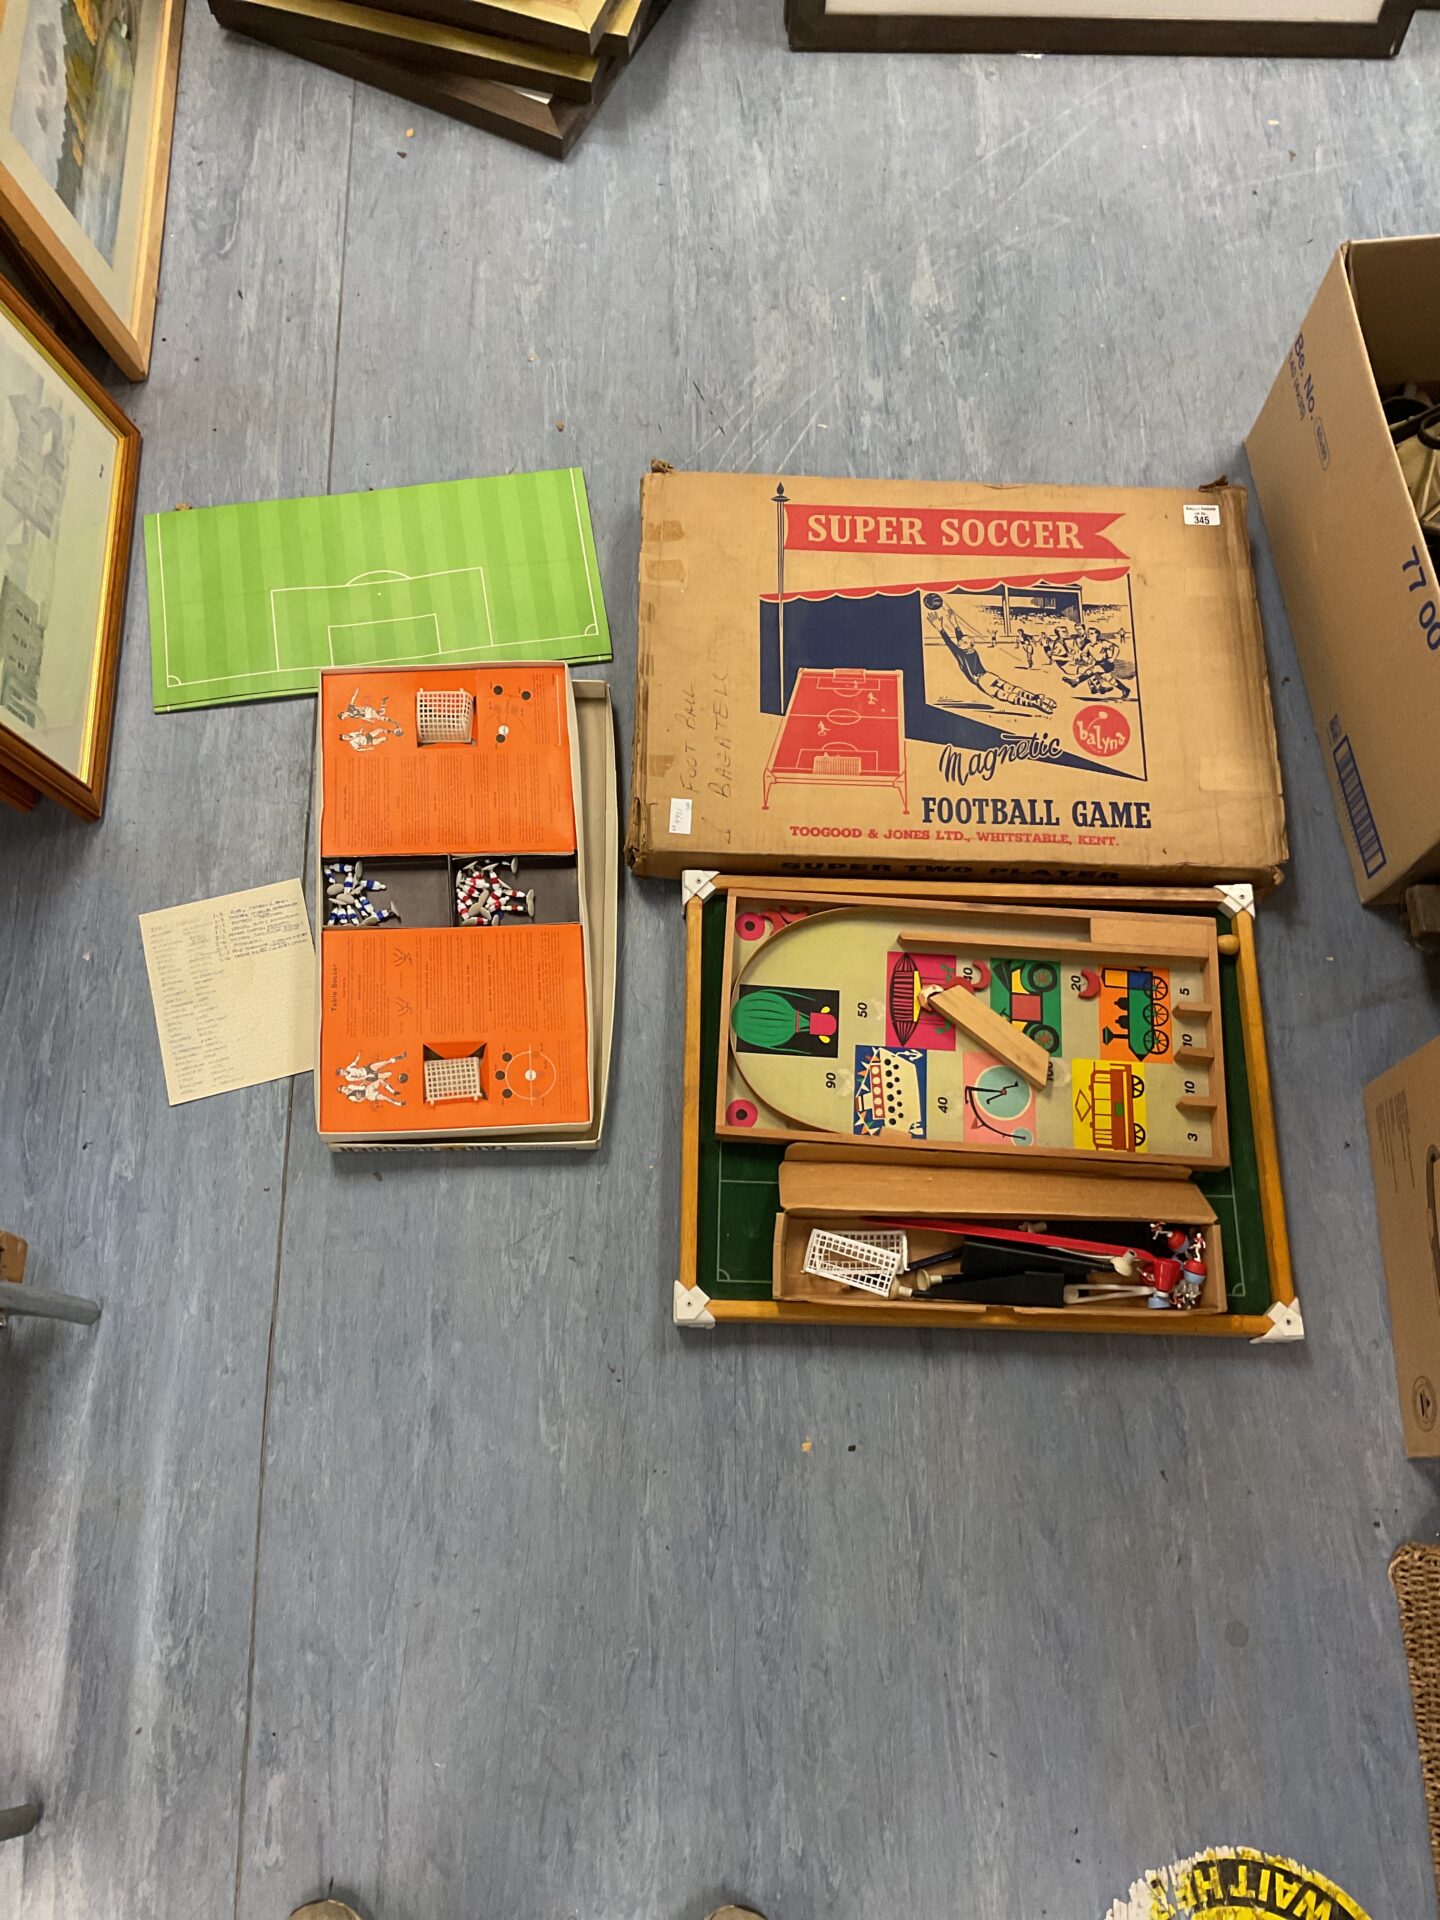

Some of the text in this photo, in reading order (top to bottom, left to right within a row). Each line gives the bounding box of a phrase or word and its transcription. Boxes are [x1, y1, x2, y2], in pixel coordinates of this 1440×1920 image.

[1194, 515, 1210, 525] 345
[807, 514, 1084, 550] SUPER SOCCER
[1402, 544, 1427, 592] 77
[938, 731, 1064, 786] Magnetic
[921, 796, 1152, 829] FOOTBALL GAME
[789, 825, 863, 839] TOOGOOD
[867, 828, 879, 840] &
[883, 828, 931, 841] JONES
[975, 830, 1073, 846] WHITSTABLE,
[1077, 833, 1120, 847] KENT.
[779, 861, 1122, 880] SUPER TWO PLAYER
[1071, 976, 1081, 991] 20
[1180, 988, 1190, 996] 5
[857, 1002, 868, 1018] 50
[1182, 1034, 1193, 1047] 10
[826, 1072, 837, 1089] 90
[1184, 1081, 1195, 1095] 10
[937, 1097, 948, 1114] 40
[1187, 1133, 1198, 1142] 3
[1229, 1865, 1332, 1920] WAIT
